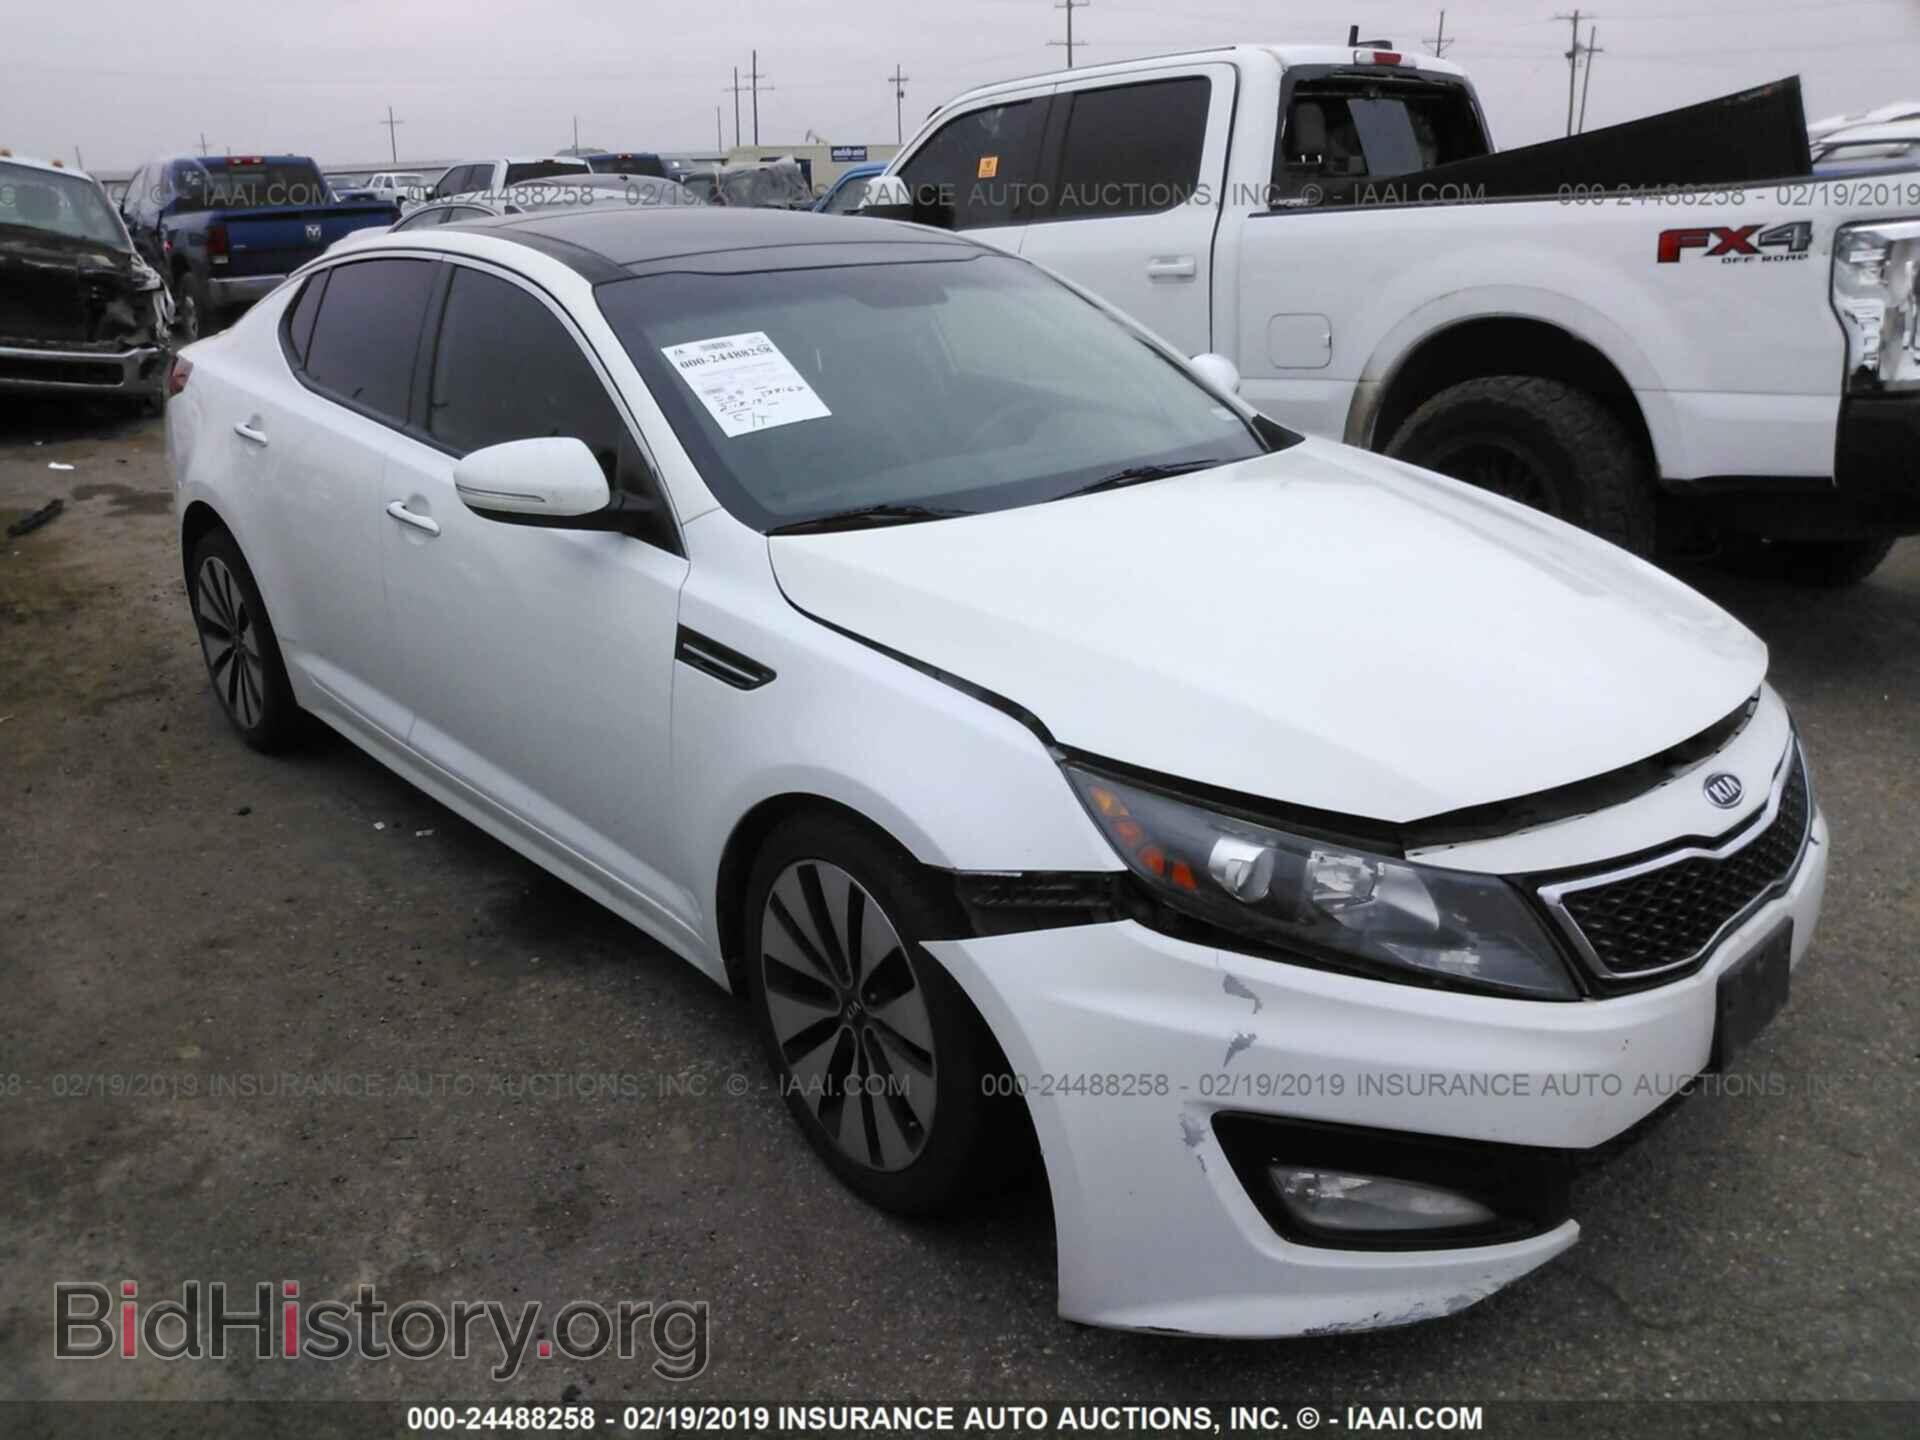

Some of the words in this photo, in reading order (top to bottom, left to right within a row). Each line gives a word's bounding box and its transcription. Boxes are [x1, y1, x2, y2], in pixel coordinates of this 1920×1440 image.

[1656, 220, 1812, 263] FX4
[1721, 256, 1751, 264] OFF
[1761, 253, 1808, 263] ROAD
[1709, 776, 1741, 802] KIA
